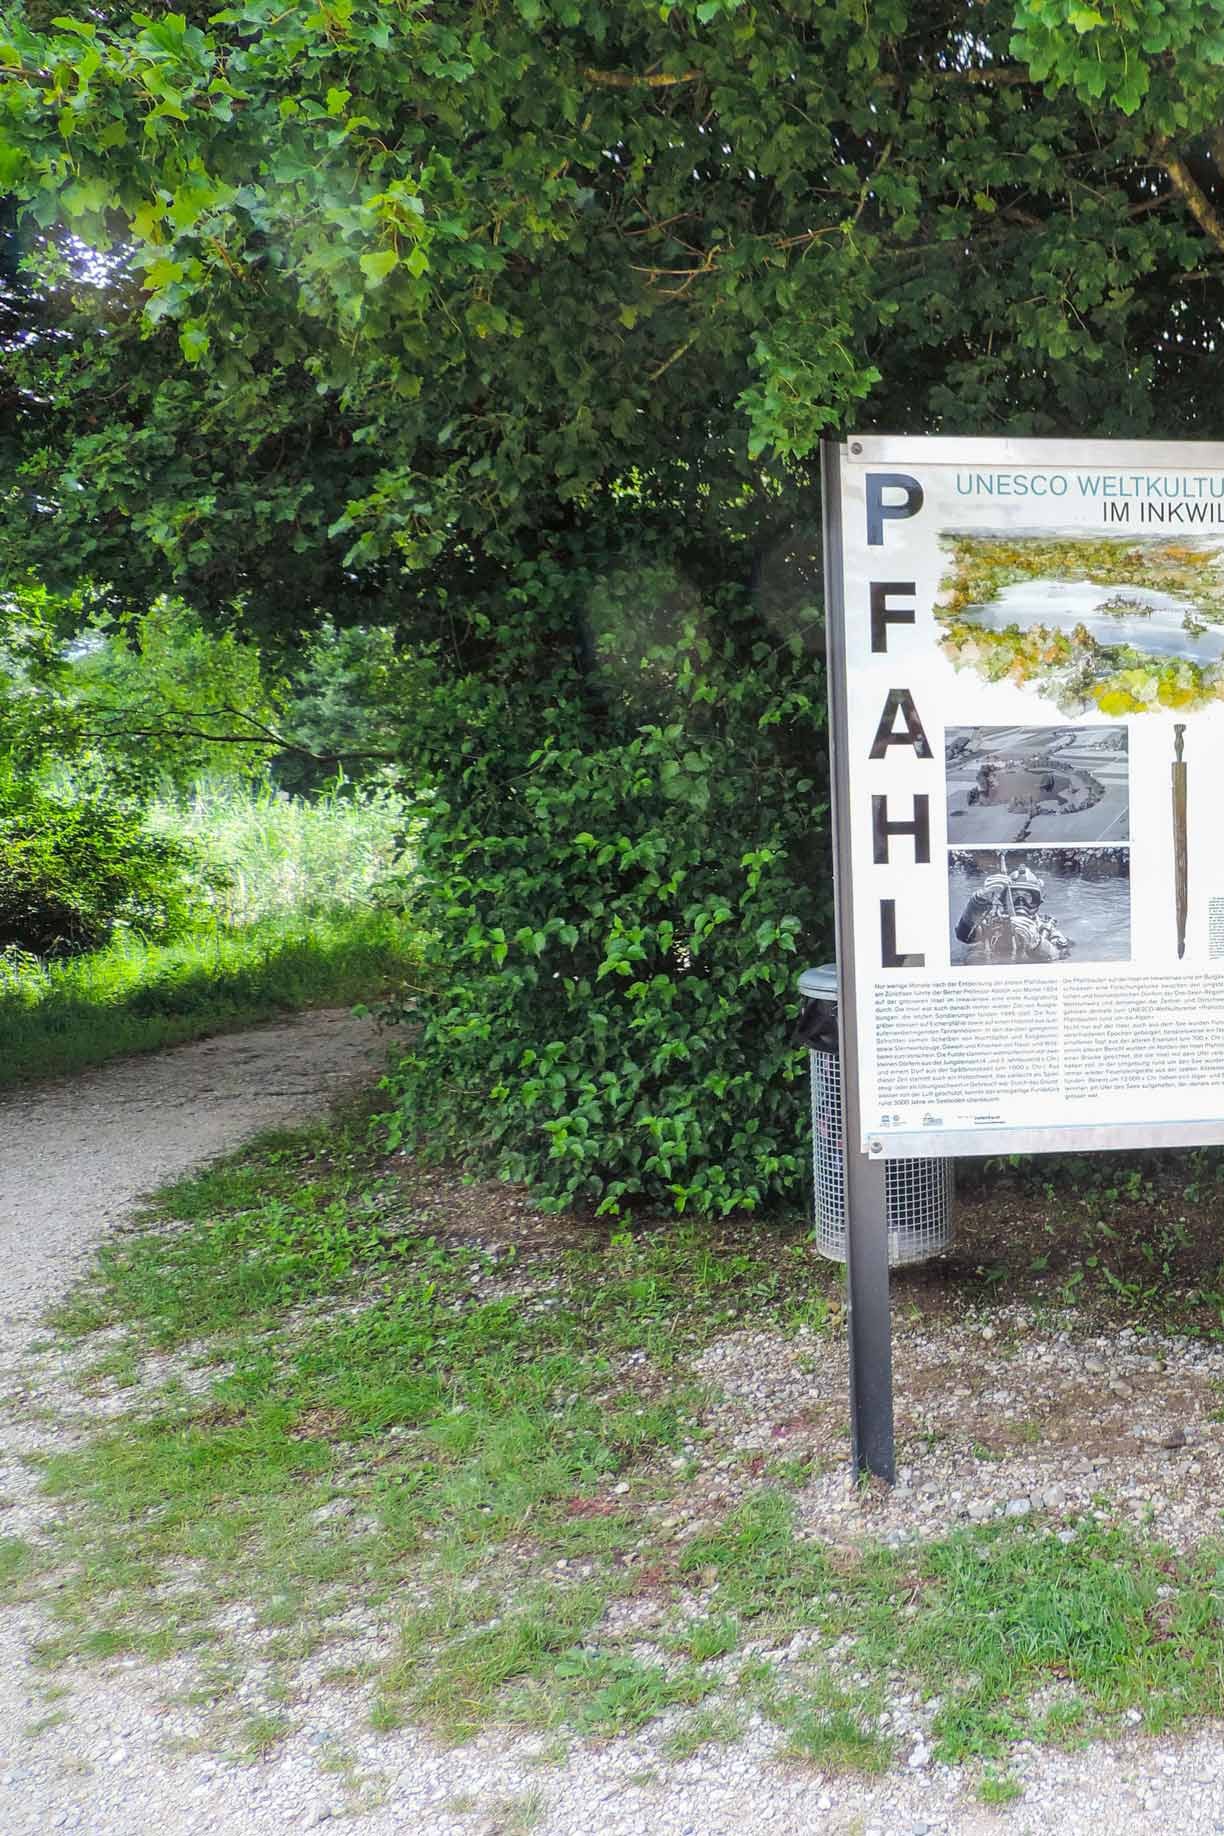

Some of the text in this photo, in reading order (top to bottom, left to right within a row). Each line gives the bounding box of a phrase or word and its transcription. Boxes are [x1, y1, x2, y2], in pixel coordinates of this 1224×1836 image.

[956, 474, 1068, 496] UNESCO
[1102, 501, 1130, 523] IM
[865, 472, 934, 968] PFAHL
